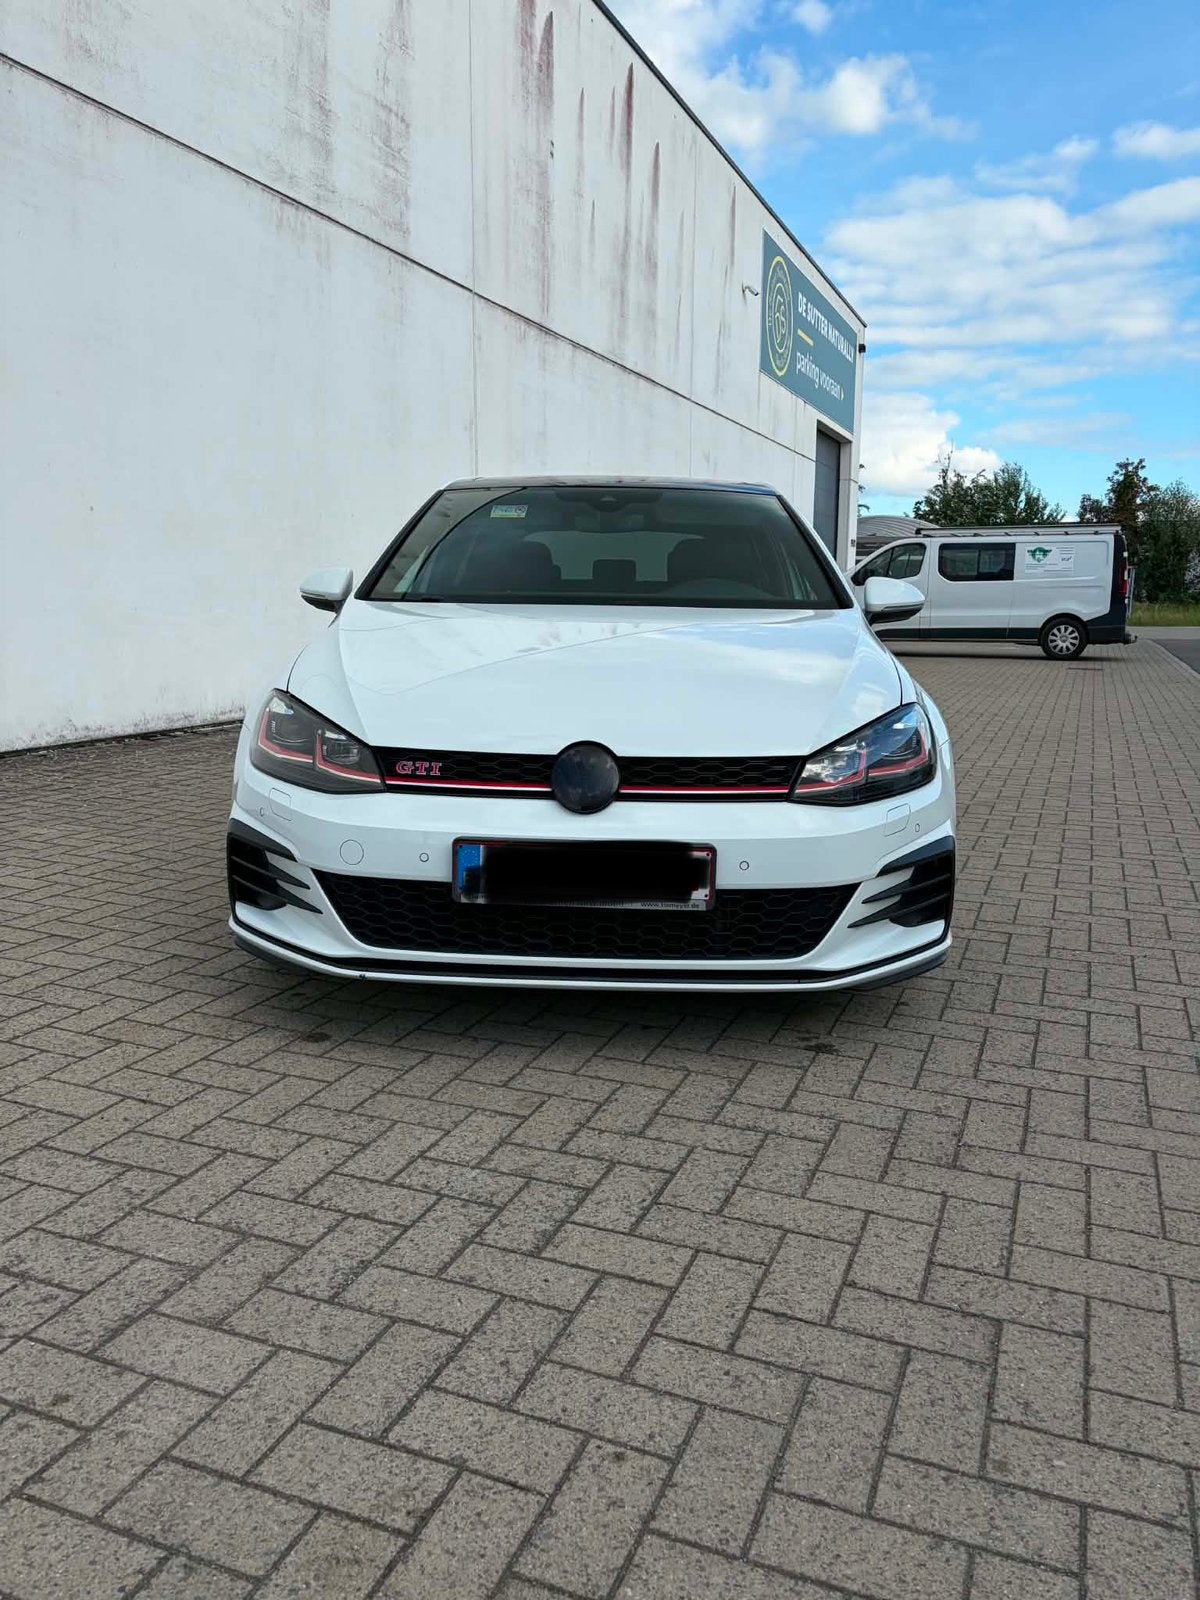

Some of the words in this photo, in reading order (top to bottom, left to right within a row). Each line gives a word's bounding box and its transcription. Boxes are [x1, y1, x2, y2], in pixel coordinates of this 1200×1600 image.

[798, 291, 807, 318] DE
[807, 302, 828, 339] SUTTER
[828, 320, 855, 364] NATURALLY
[796, 351, 820, 389] parking
[395, 760, 443, 776] GTI
